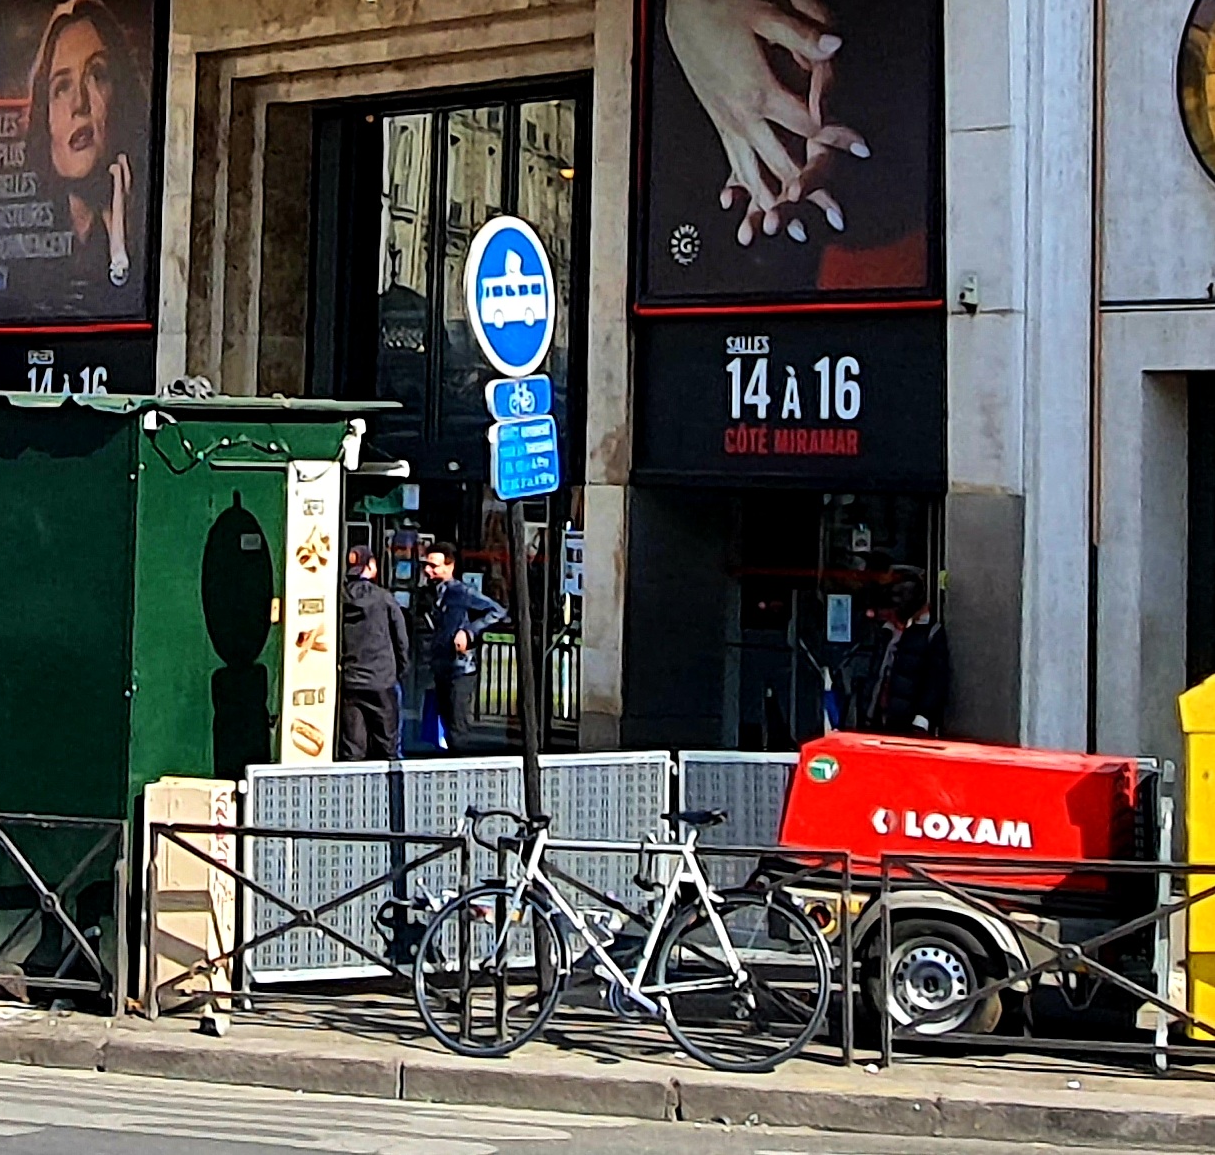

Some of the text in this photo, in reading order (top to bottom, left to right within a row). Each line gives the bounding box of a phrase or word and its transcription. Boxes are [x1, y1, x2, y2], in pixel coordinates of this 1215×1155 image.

[725, 336, 770, 354] SALLES
[726, 356, 861, 420] 14 À 16
[724, 423, 859, 455] CÔTÉ MIRAMAR
[904, 810, 1033, 849] LOXAM
